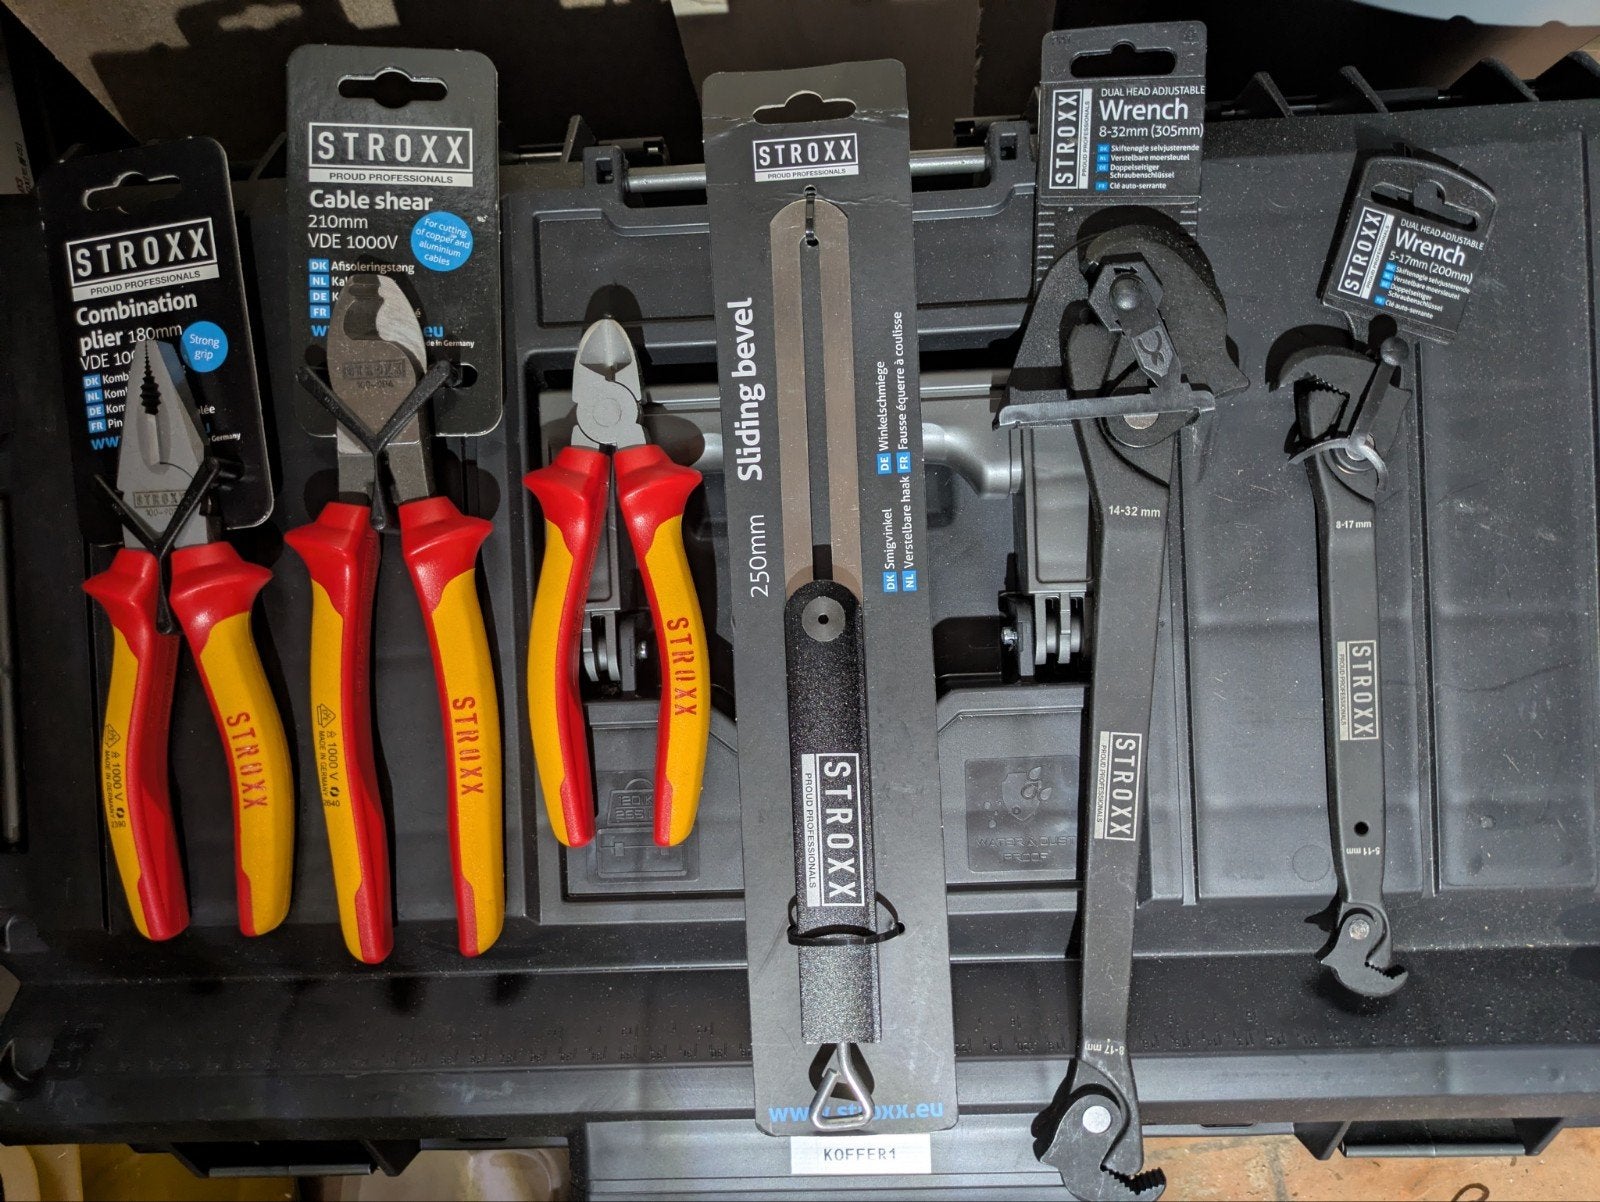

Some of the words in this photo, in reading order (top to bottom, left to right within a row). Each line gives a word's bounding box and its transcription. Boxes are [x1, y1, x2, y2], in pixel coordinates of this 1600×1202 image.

[1101, 88, 1125, 97] DUAL
[1126, 87, 1150, 97] HEAD
[1152, 85, 1205, 96] ADJUSTABLE
[1099, 98, 1188, 120] Wrench
[1055, 95, 1078, 184] STROXX
[1099, 125, 1148, 137] 8-32mm
[1151, 124, 1204, 138] (305mm)
[318, 131, 464, 164] STROXX
[759, 140, 852, 166] STROXX
[329, 172, 366, 181] PROUD
[369, 173, 453, 184] PROFESSIONALS
[768, 172, 791, 180] PROUD
[792, 168, 846, 177] PROFESSIONALS
[310, 189, 370, 210] Cable
[375, 191, 433, 211] shear
[308, 214, 368, 229] 210mm
[424, 218, 438, 228] For
[438, 223, 468, 239] cutting
[308, 233, 341, 248] VDE
[347, 234, 399, 250] 1000V
[415, 228, 426, 237] of
[426, 230, 454, 245] copper
[454, 238, 471, 249] and
[1400, 219, 1419, 231] DUAL
[1420, 224, 1440, 237] HEAD
[1441, 231, 1485, 250] ADJUSTABLE
[75, 227, 208, 277] STROXX
[419, 240, 461, 258] aluminium
[1344, 213, 1381, 291] STROXX
[1395, 227, 1466, 267] Wrench
[312, 262, 327, 270] DK
[331, 261, 415, 274] Afisoleringstang
[424, 253, 451, 266] cables
[1388, 251, 1428, 270] 5-17mm
[1429, 261, 1473, 285] (200mm)
[90, 282, 123, 296] PROUD
[124, 271, 201, 289] PROFESSIONALS
[313, 277, 327, 286] NL
[313, 293, 327, 301] DE
[76, 293, 198, 326] Combination
[314, 308, 327, 317] FR
[80, 329, 123, 357] plier
[128, 324, 183, 344] 180mm
[189, 333, 220, 349] Strong
[443, 340, 475, 349] Germany
[727, 297, 756, 377] bevel
[892, 311, 904, 357] coulisse
[80, 353, 109, 371] VDE
[194, 349, 214, 361] grip
[894, 358, 904, 366] à
[85, 377, 99, 387] DK
[896, 367, 909, 412] équerre
[87, 391, 100, 400] NL
[877, 361, 889, 451] Winkelschmiege
[89, 407, 102, 416] DE
[91, 421, 103, 431] FR
[734, 383, 766, 481] Sliding
[898, 413, 908, 450] Fausse
[880, 457, 889, 471] DE
[900, 455, 909, 470] FR
[900, 475, 911, 503] haak
[1108, 505, 1138, 517] 14-32
[1140, 509, 1161, 518] mm
[1336, 520, 1354, 529] 8-17
[882, 508, 896, 570] Smigvinkel
[902, 504, 914, 569] Verstelbare
[749, 514, 770, 598] 250mm
[886, 574, 895, 590] DK
[905, 574, 914, 588] NL
[1352, 646, 1374, 734] STROXX
[319, 730, 327, 750] MADE
[328, 742, 339, 769] 1000
[106, 772, 111, 780] IN
[112, 763, 123, 789] 1000
[320, 762, 329, 796] GERMANY
[329, 772, 339, 781] V
[1110, 738, 1136, 835] STROXX
[106, 782, 116, 818] GERMANY
[114, 792, 124, 801] V
[805, 772, 814, 807] PROUD
[824, 762, 857, 898] STROXX
[807, 809, 817, 889] PROFESSIONALS
[1003, 852, 1049, 863] PROOF
[823, 1148, 896, 1161] KOFFER1
